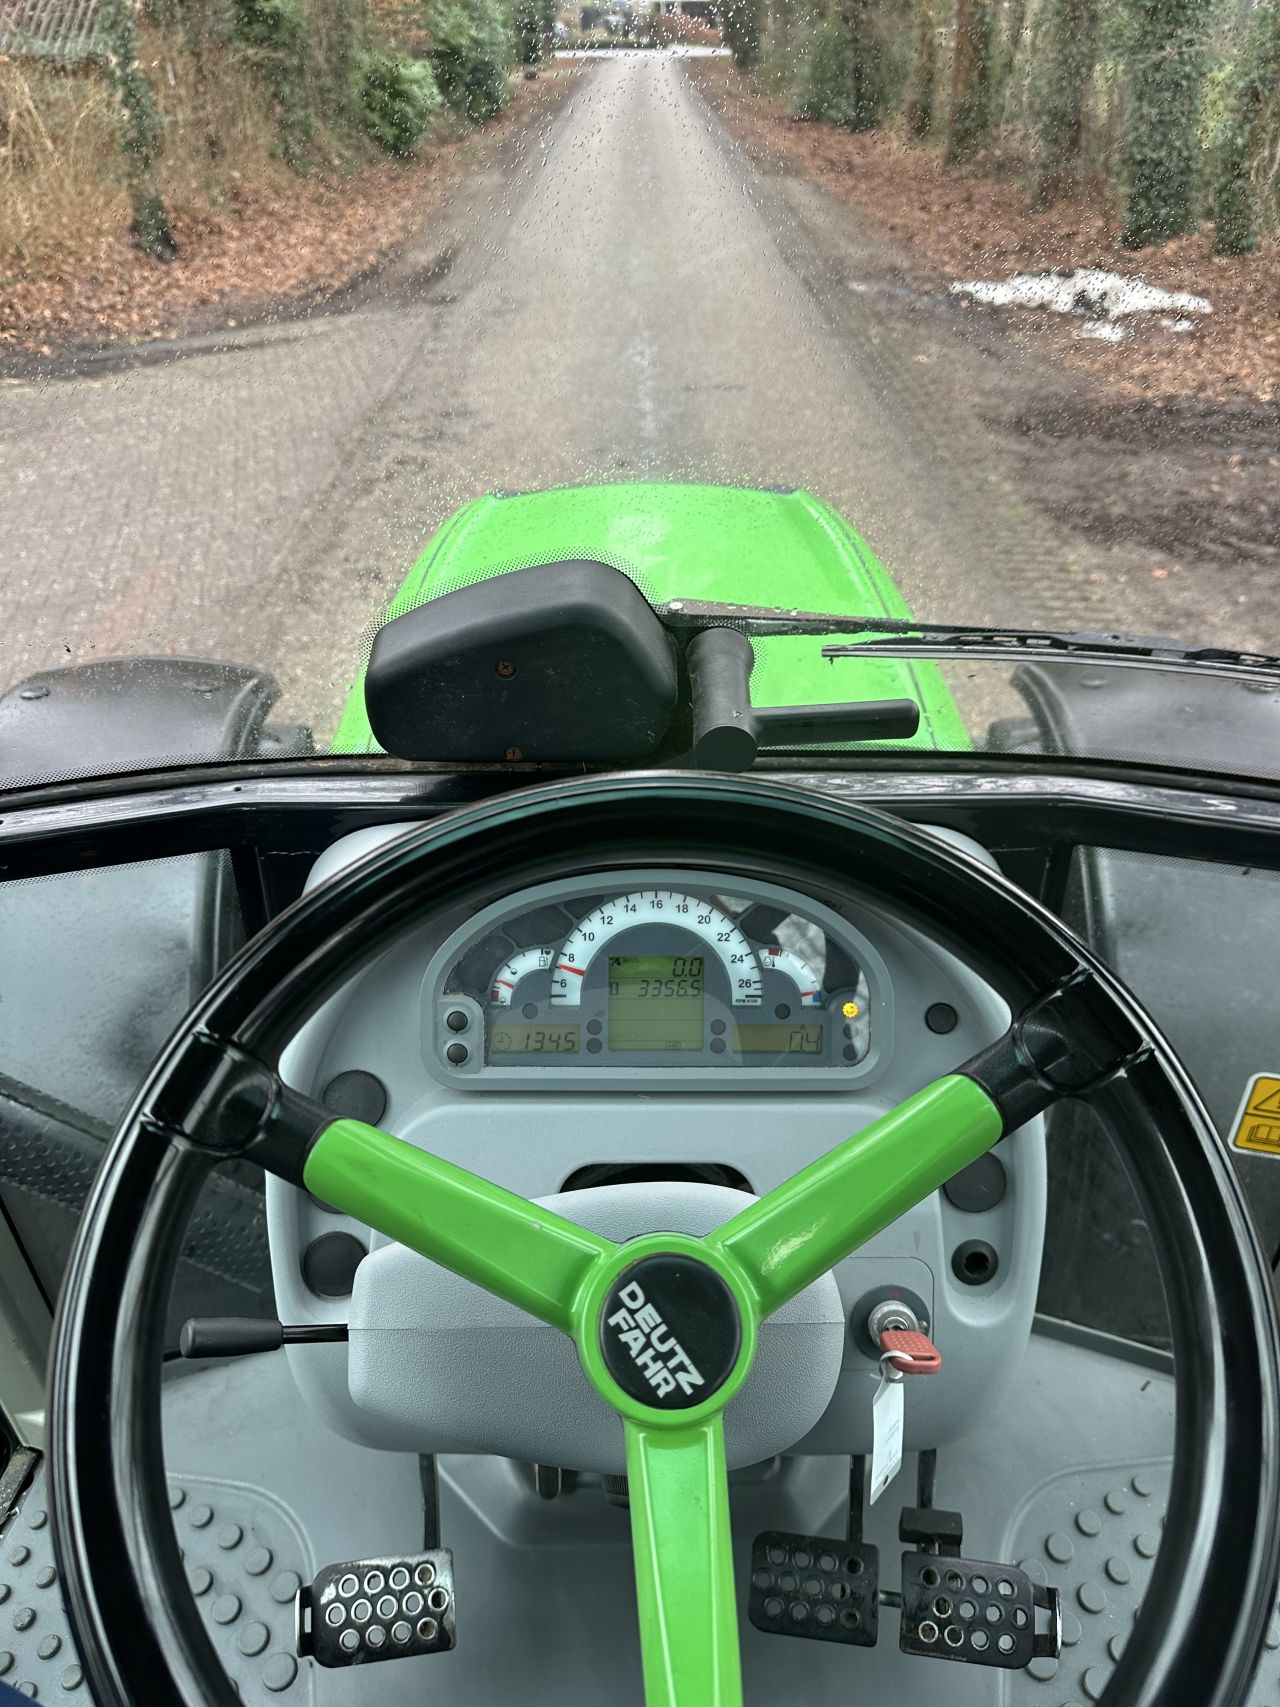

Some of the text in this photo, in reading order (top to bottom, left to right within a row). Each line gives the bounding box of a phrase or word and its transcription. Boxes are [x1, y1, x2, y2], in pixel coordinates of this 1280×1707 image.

[623, 904, 637, 913] 14
[649, 900, 663, 909] 16
[675, 904, 689, 913] 18
[600, 915, 614, 925] 12
[697, 915, 711, 924] 20
[581, 932, 595, 941] 10
[717, 932, 731, 942] 22
[568, 953, 575, 962] 8
[730, 954, 744, 963] 24
[672, 957, 703, 977] 0.0
[560, 978, 567, 988] 6
[738, 979, 752, 988] 26
[638, 979, 701, 997] 3356.5
[524, 1031, 576, 1051] 1345
[618, 1280, 706, 1396] DEUTZ
[607, 1309, 677, 1399] FAHR
